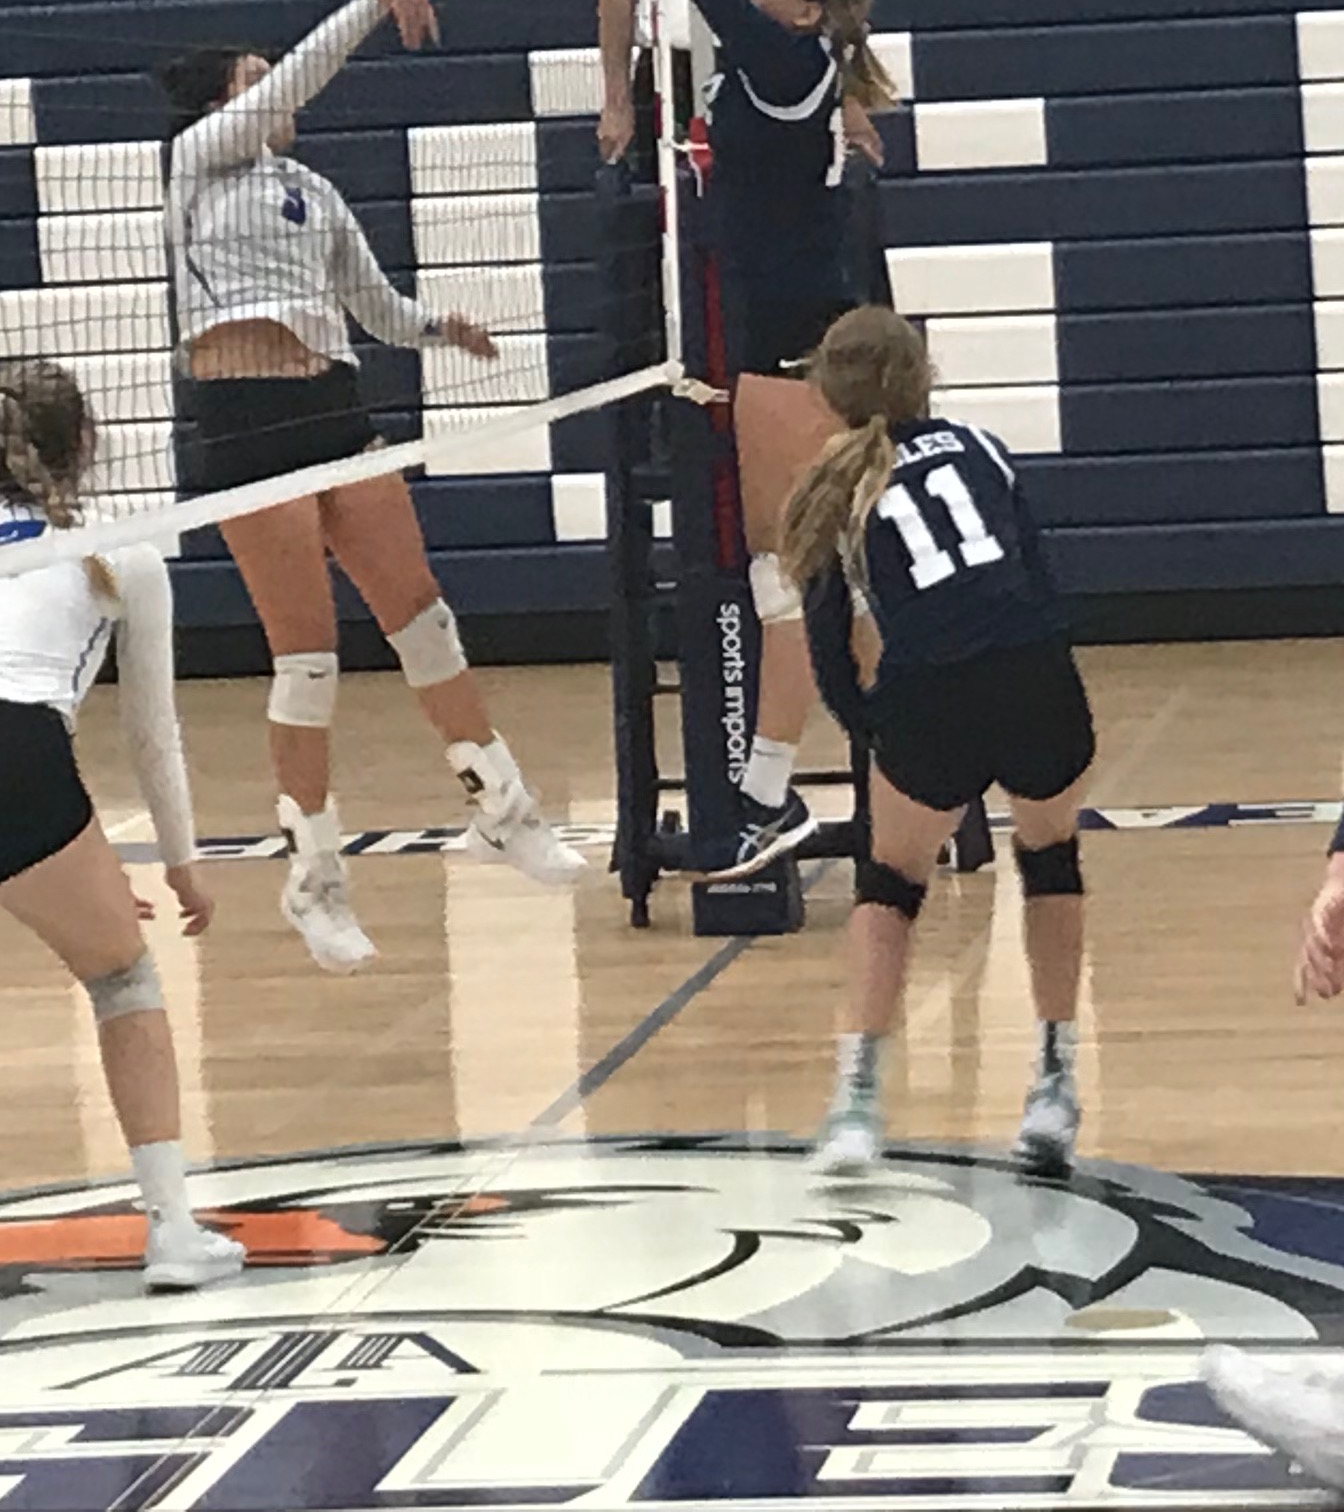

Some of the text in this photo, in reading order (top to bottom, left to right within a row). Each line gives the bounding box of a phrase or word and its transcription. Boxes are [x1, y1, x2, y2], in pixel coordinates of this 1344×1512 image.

[892, 430, 966, 468] LES
[877, 464, 1004, 589] 11
[717, 603, 745, 682] sports
